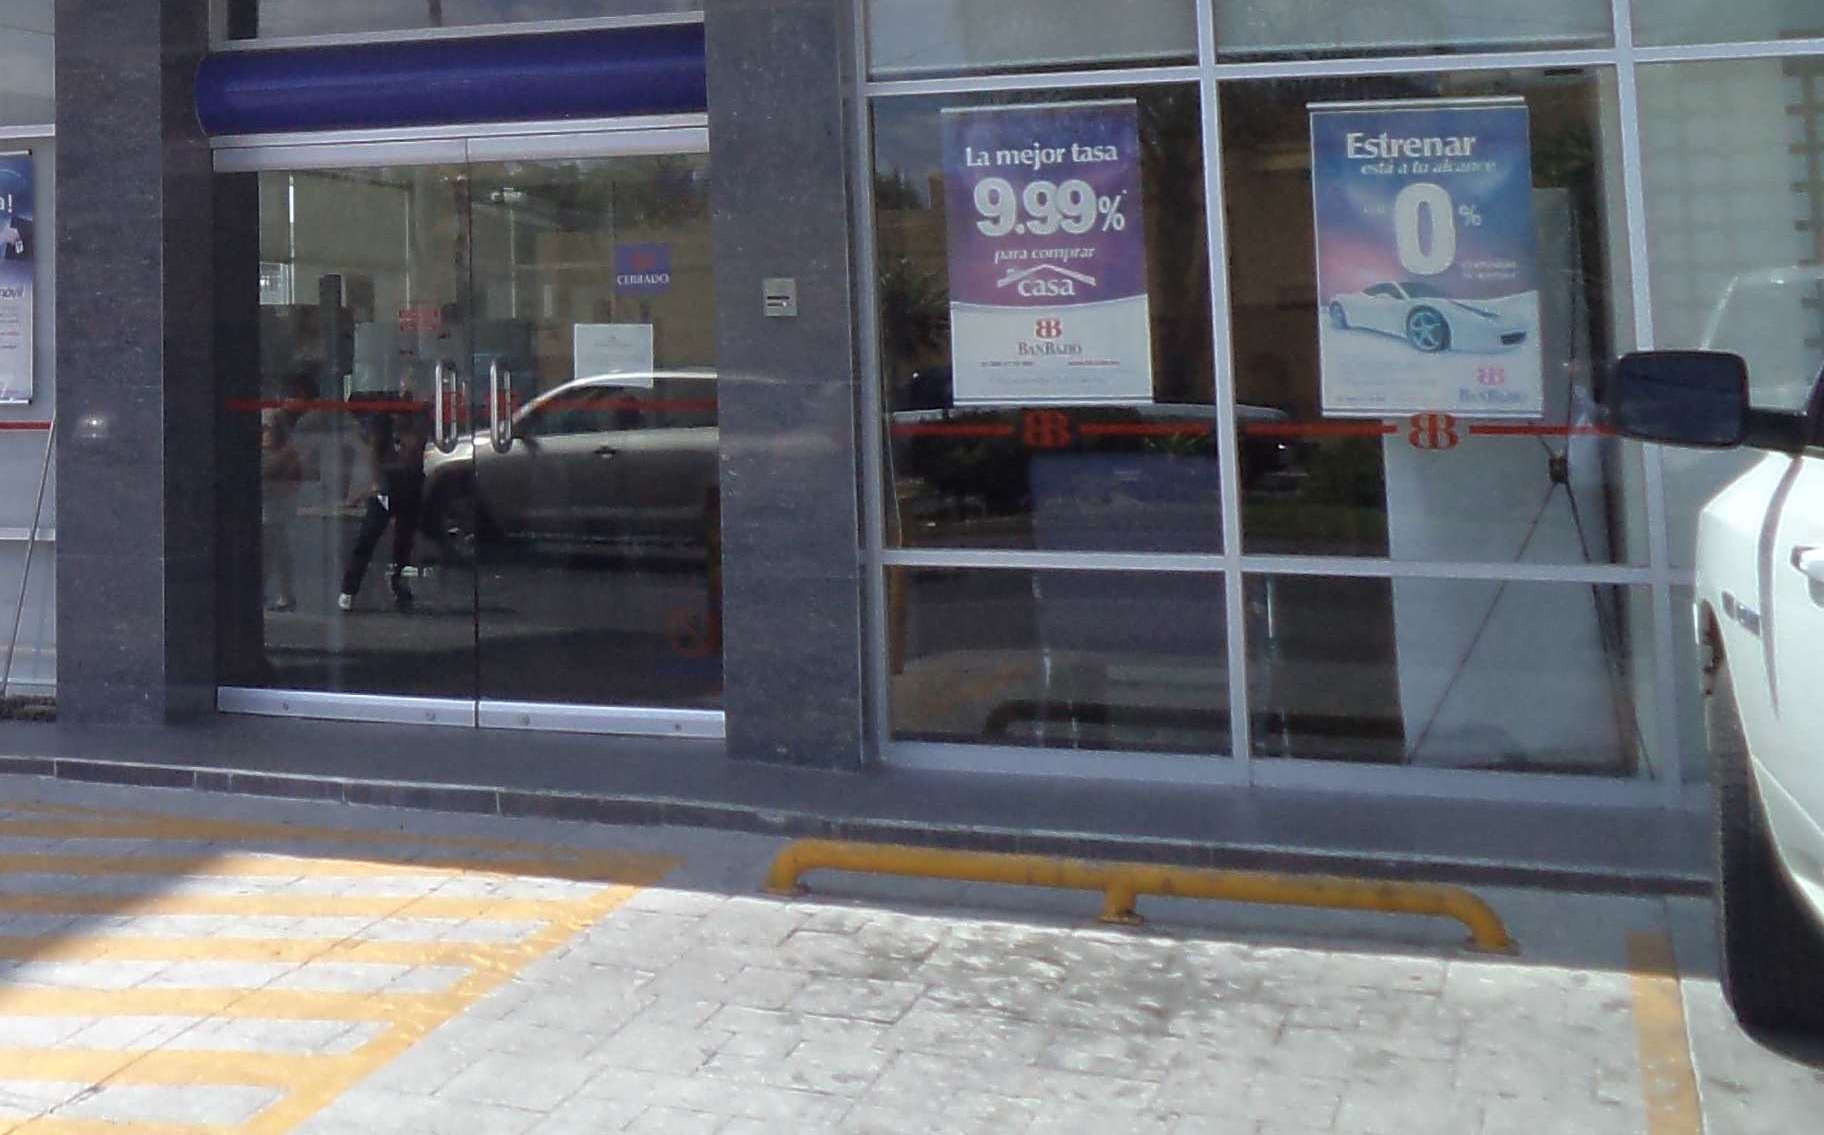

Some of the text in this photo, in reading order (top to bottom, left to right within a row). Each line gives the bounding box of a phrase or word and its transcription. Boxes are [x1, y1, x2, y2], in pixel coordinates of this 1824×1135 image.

[1346, 131, 1476, 159] Estrenar
[966, 142, 1119, 170] La mejor tasa
[994, 247, 1096, 264] para comprar
[616, 273, 671, 286] CERRADO
[1018, 278, 1076, 297] casa
